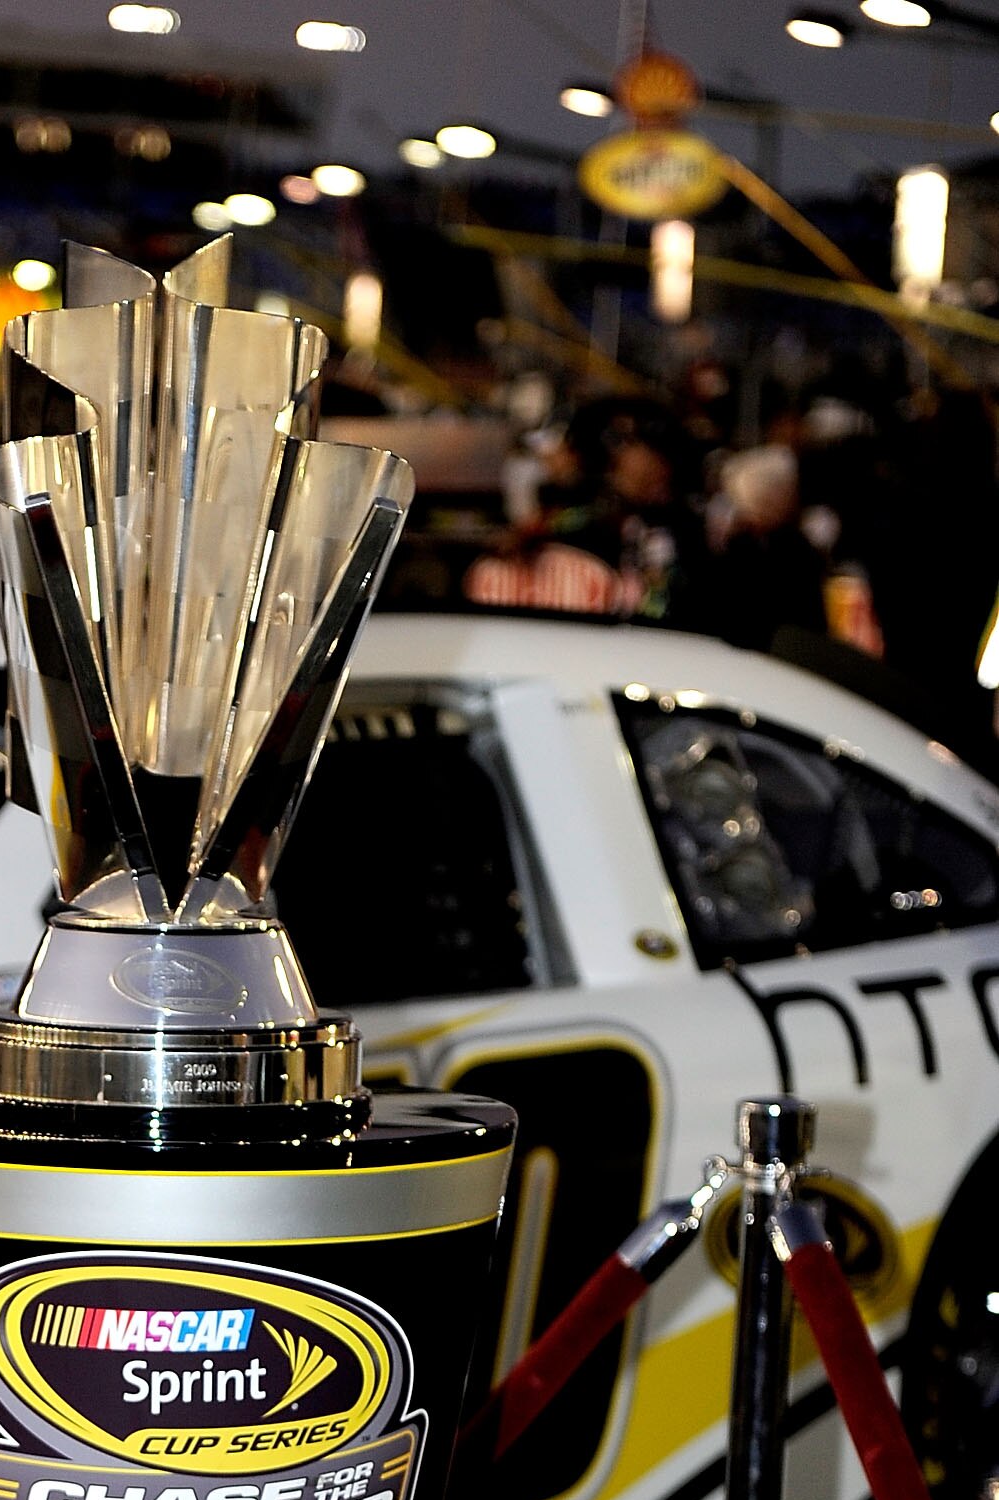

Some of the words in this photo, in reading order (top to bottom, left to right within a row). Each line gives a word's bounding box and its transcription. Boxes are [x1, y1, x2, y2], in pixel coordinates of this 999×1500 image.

[183, 1063, 217, 1077] 2009
[98, 1309, 245, 1352] NASCAR
[122, 1359, 267, 1415] Sprint
[139, 1433, 221, 1456] CUP
[228, 1418, 348, 1454] SERIES
[316, 1461, 374, 1489] FOR
